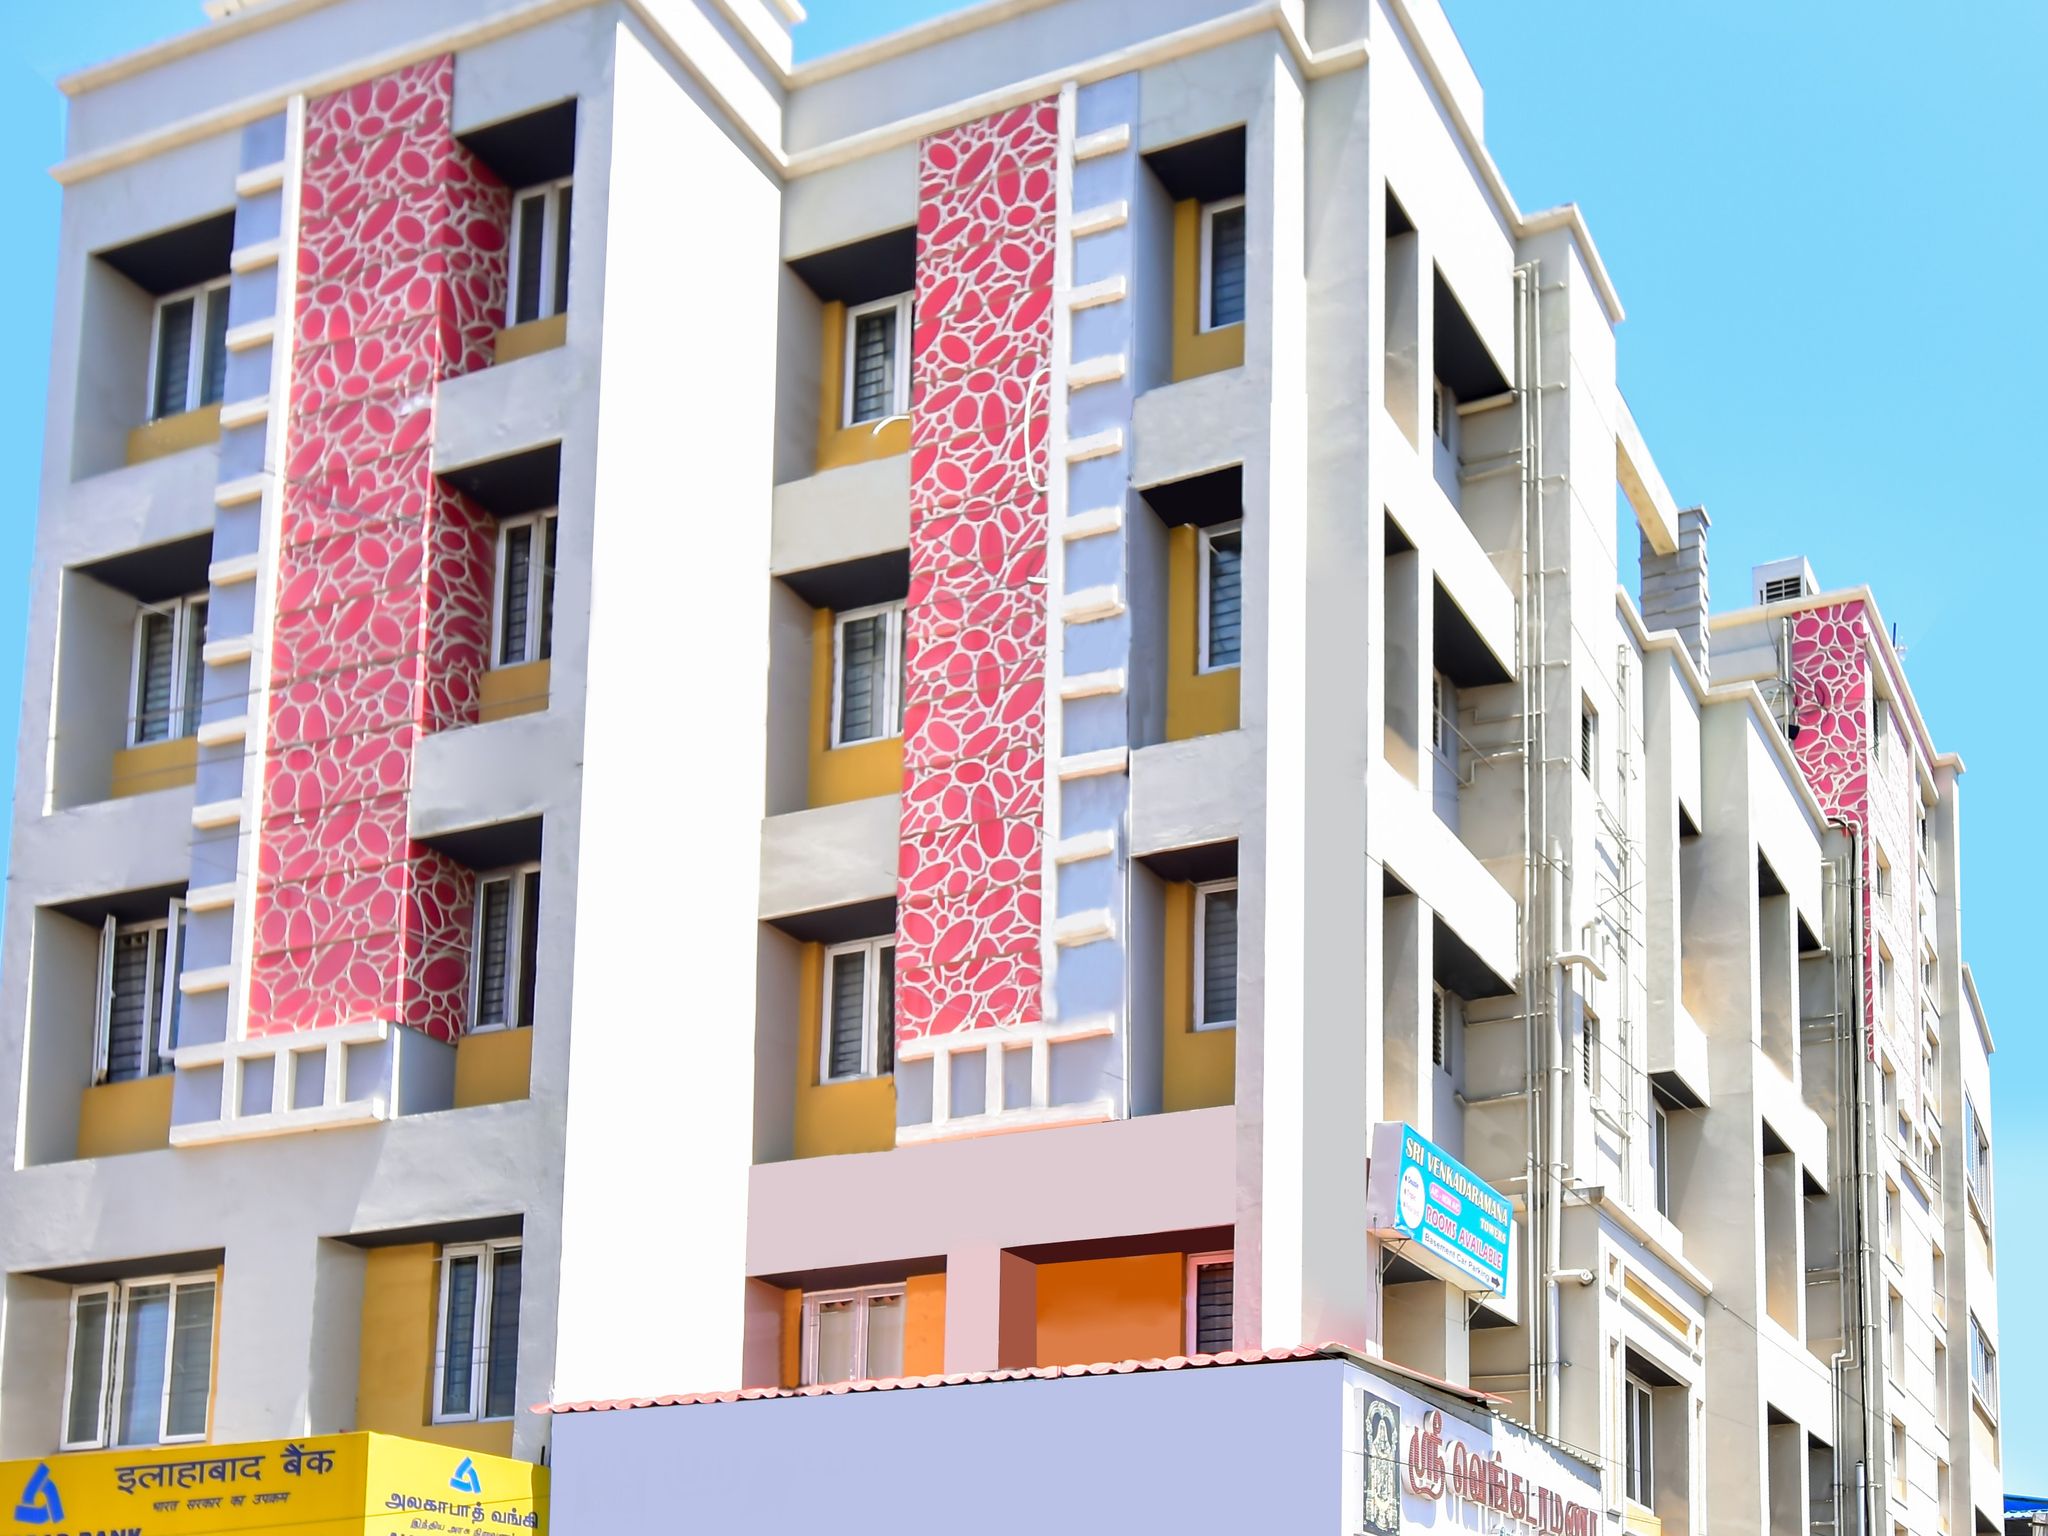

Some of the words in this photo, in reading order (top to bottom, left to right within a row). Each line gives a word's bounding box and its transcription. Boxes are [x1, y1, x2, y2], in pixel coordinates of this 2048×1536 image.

[1405, 1137, 1424, 1167] SRI
[1427, 1151, 1508, 1227] VENKADARAMANA
[1424, 1232, 1456, 1259] Basement
[1456, 1252, 1468, 1265] Car
[1468, 1260, 1490, 1283] Parking
[1426, 1205, 1457, 1239] ROOMS
[1458, 1229, 1503, 1269] AVAILABLE
[115, 1455, 266, 1495] इलाहाबाद
[280, 1443, 336, 1477] बैंक
[152, 1500, 181, 1512] भारत
[186, 1496, 224, 1510] सरकार
[230, 1494, 247, 1506] का
[385, 1492, 485, 1524] அலகாபாத்
[491, 1507, 539, 1529] வங்கி
